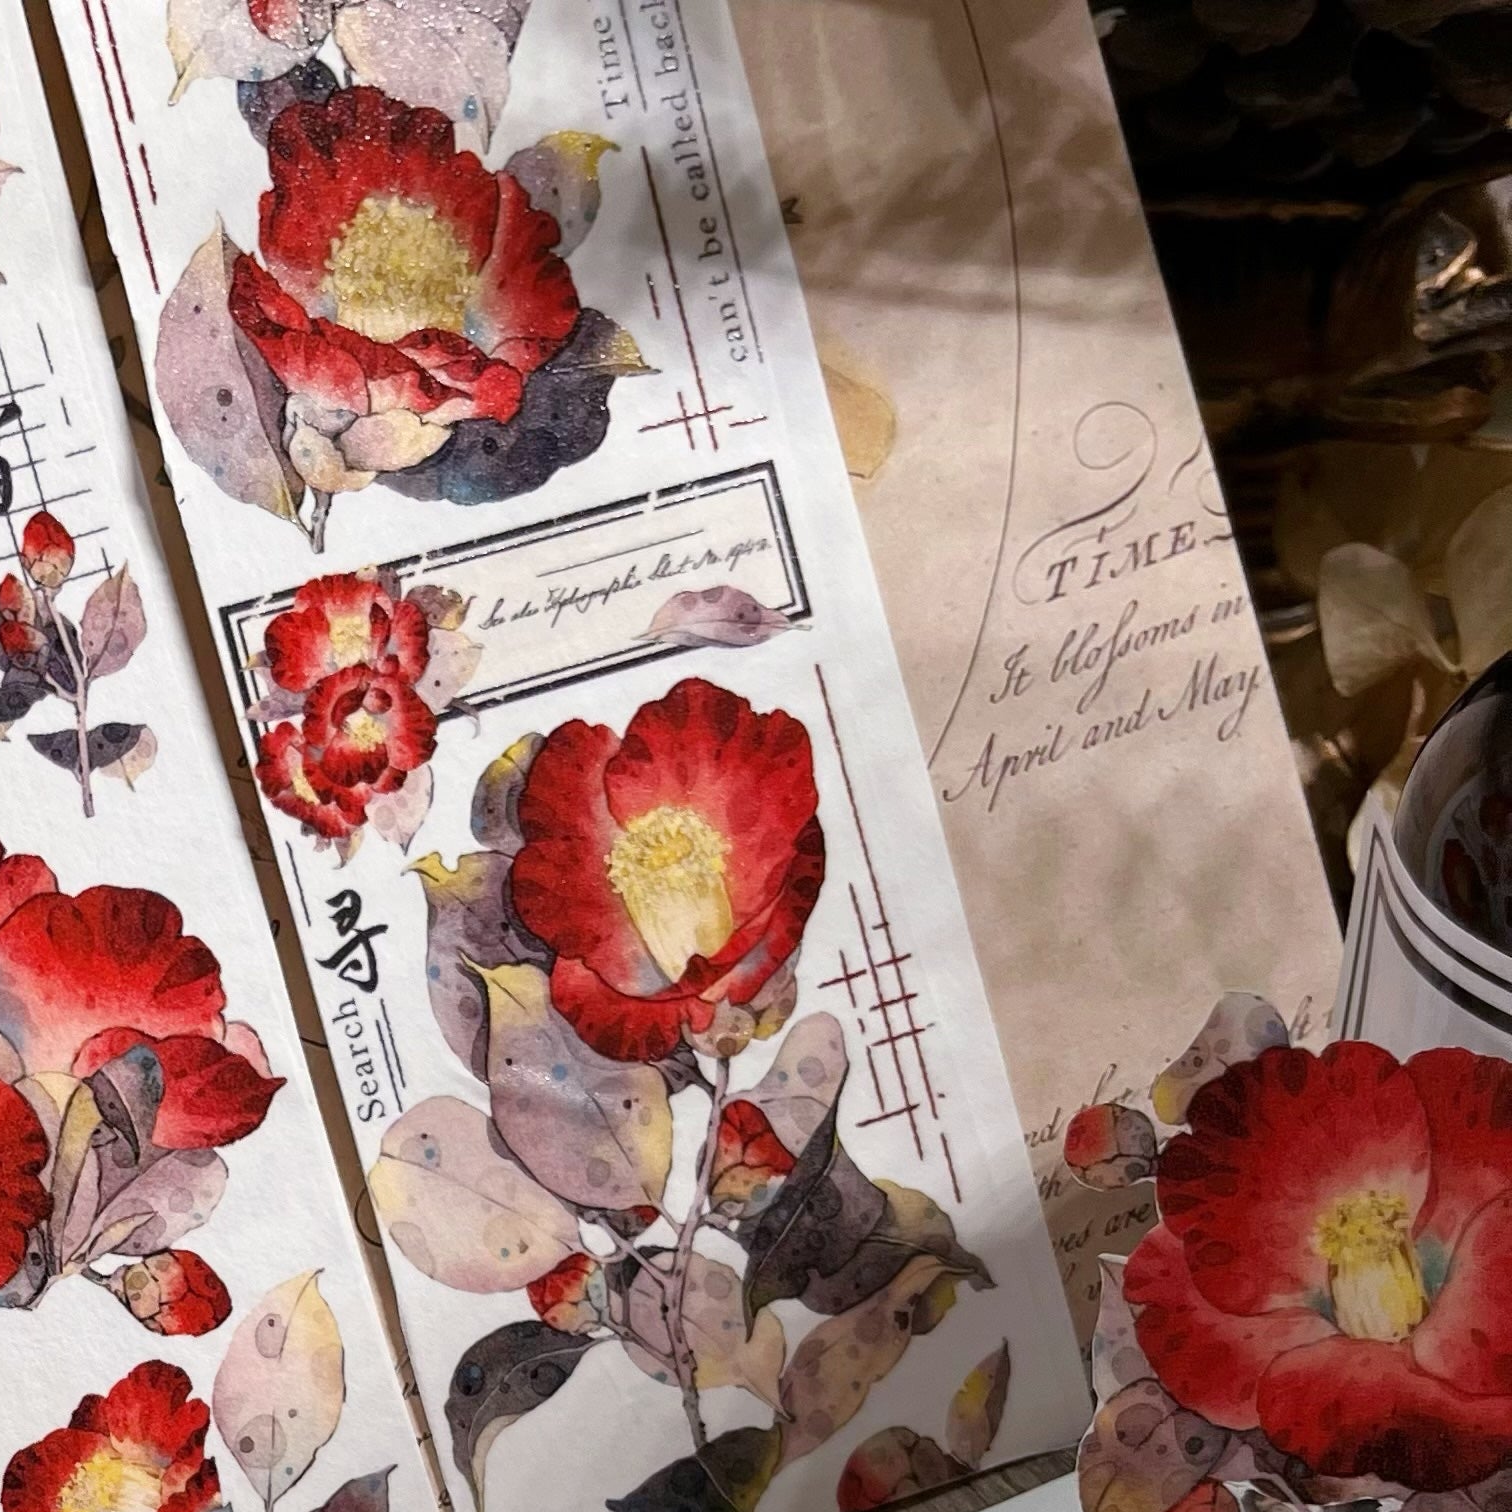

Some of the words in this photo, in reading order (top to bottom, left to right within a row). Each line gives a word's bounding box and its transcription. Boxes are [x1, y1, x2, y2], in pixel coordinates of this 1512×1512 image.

[593, 16, 629, 120] Time
[661, 89, 710, 201] called
[698, 216, 724, 262] be
[708, 271, 748, 363] can't
[990, 643, 1036, 705] It
[943, 725, 1066, 813] April
[1081, 688, 1152, 751] and
[332, 996, 387, 1123] Search
